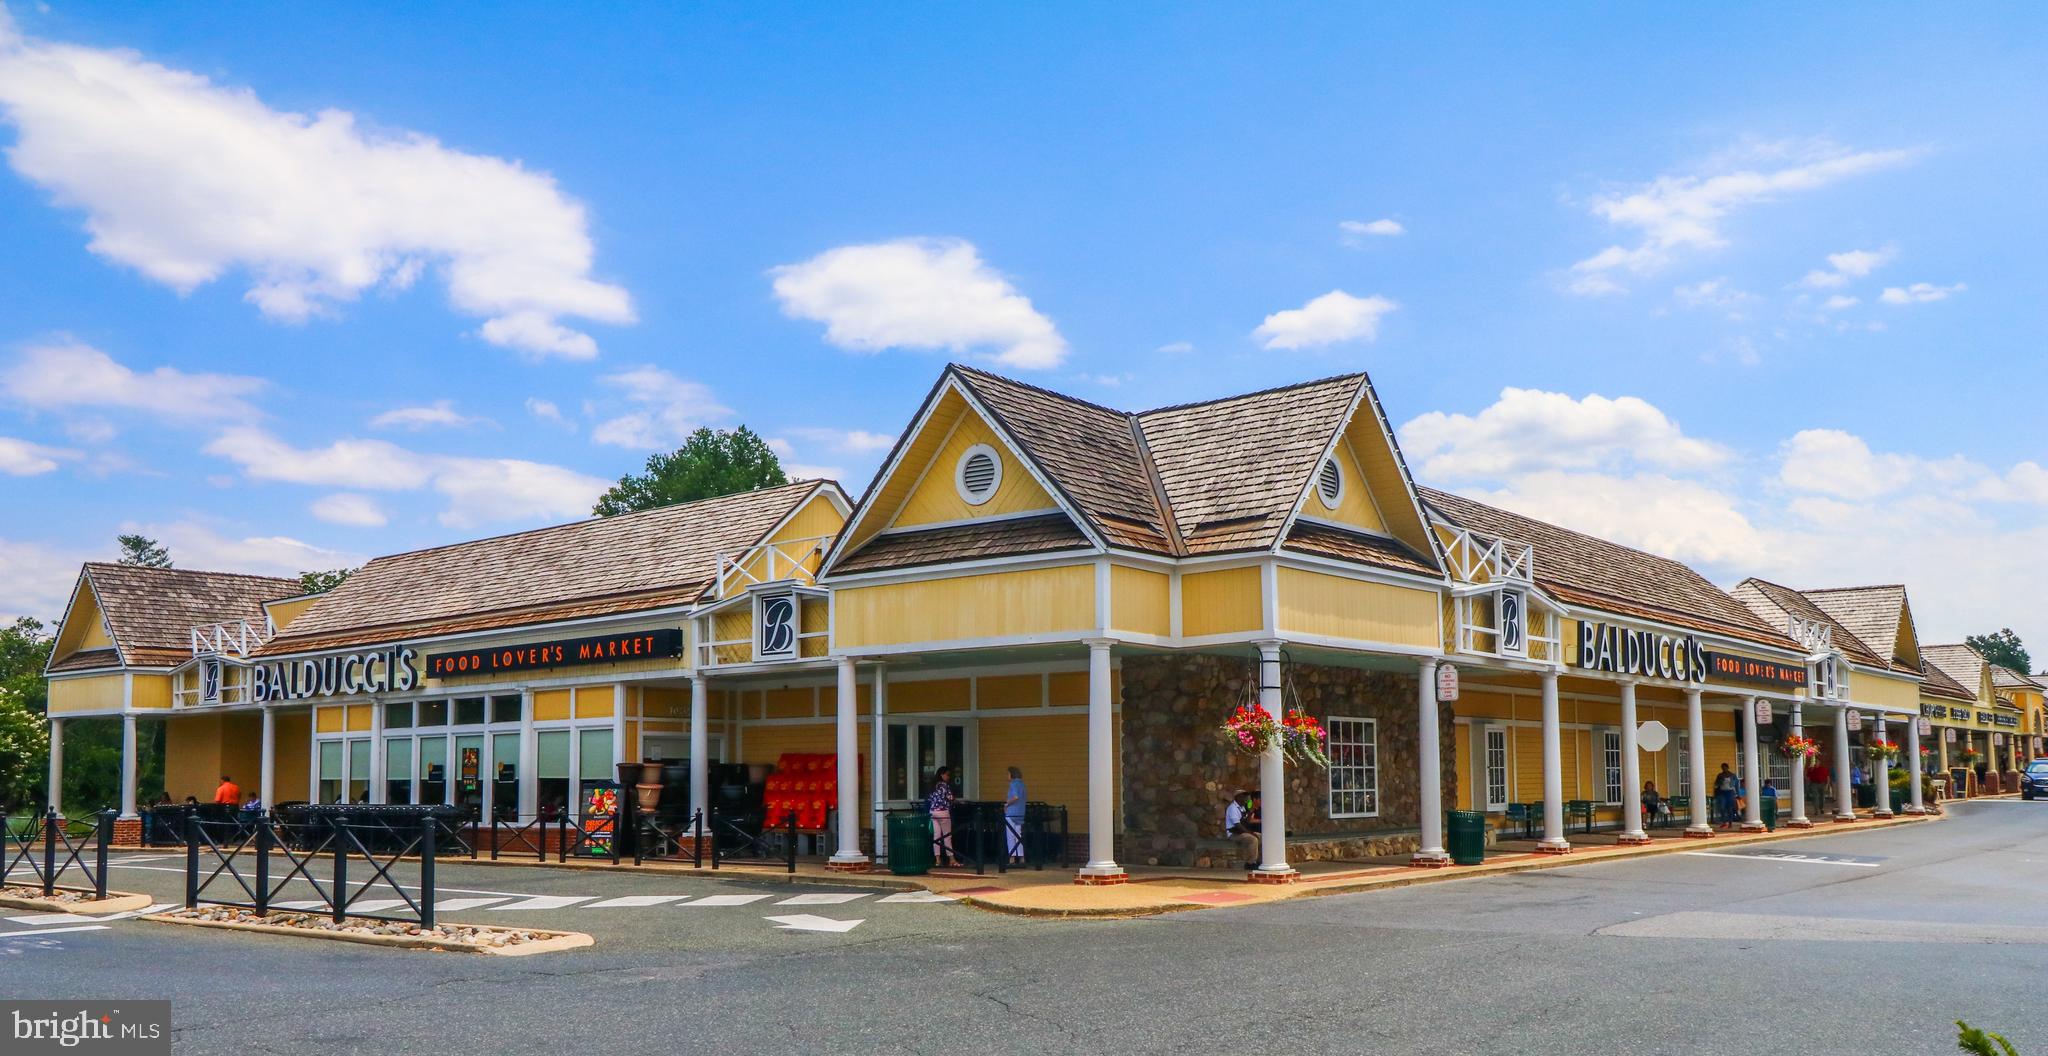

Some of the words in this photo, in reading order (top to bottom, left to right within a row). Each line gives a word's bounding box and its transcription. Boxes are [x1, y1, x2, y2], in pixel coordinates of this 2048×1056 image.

[763, 596, 793, 653] B
[1502, 592, 1518, 649] B
[253, 644, 418, 702] BALDUCCI'S
[436, 655, 480, 673] FOOD
[492, 645, 564, 668] LOVER'S
[579, 636, 655, 660] MARKET
[1577, 620, 1706, 683] BALDUCCI'S
[1716, 657, 1740, 673] FOOD
[1744, 662, 1775, 679] LOVER'S
[1779, 668, 1805, 683] MARKET
